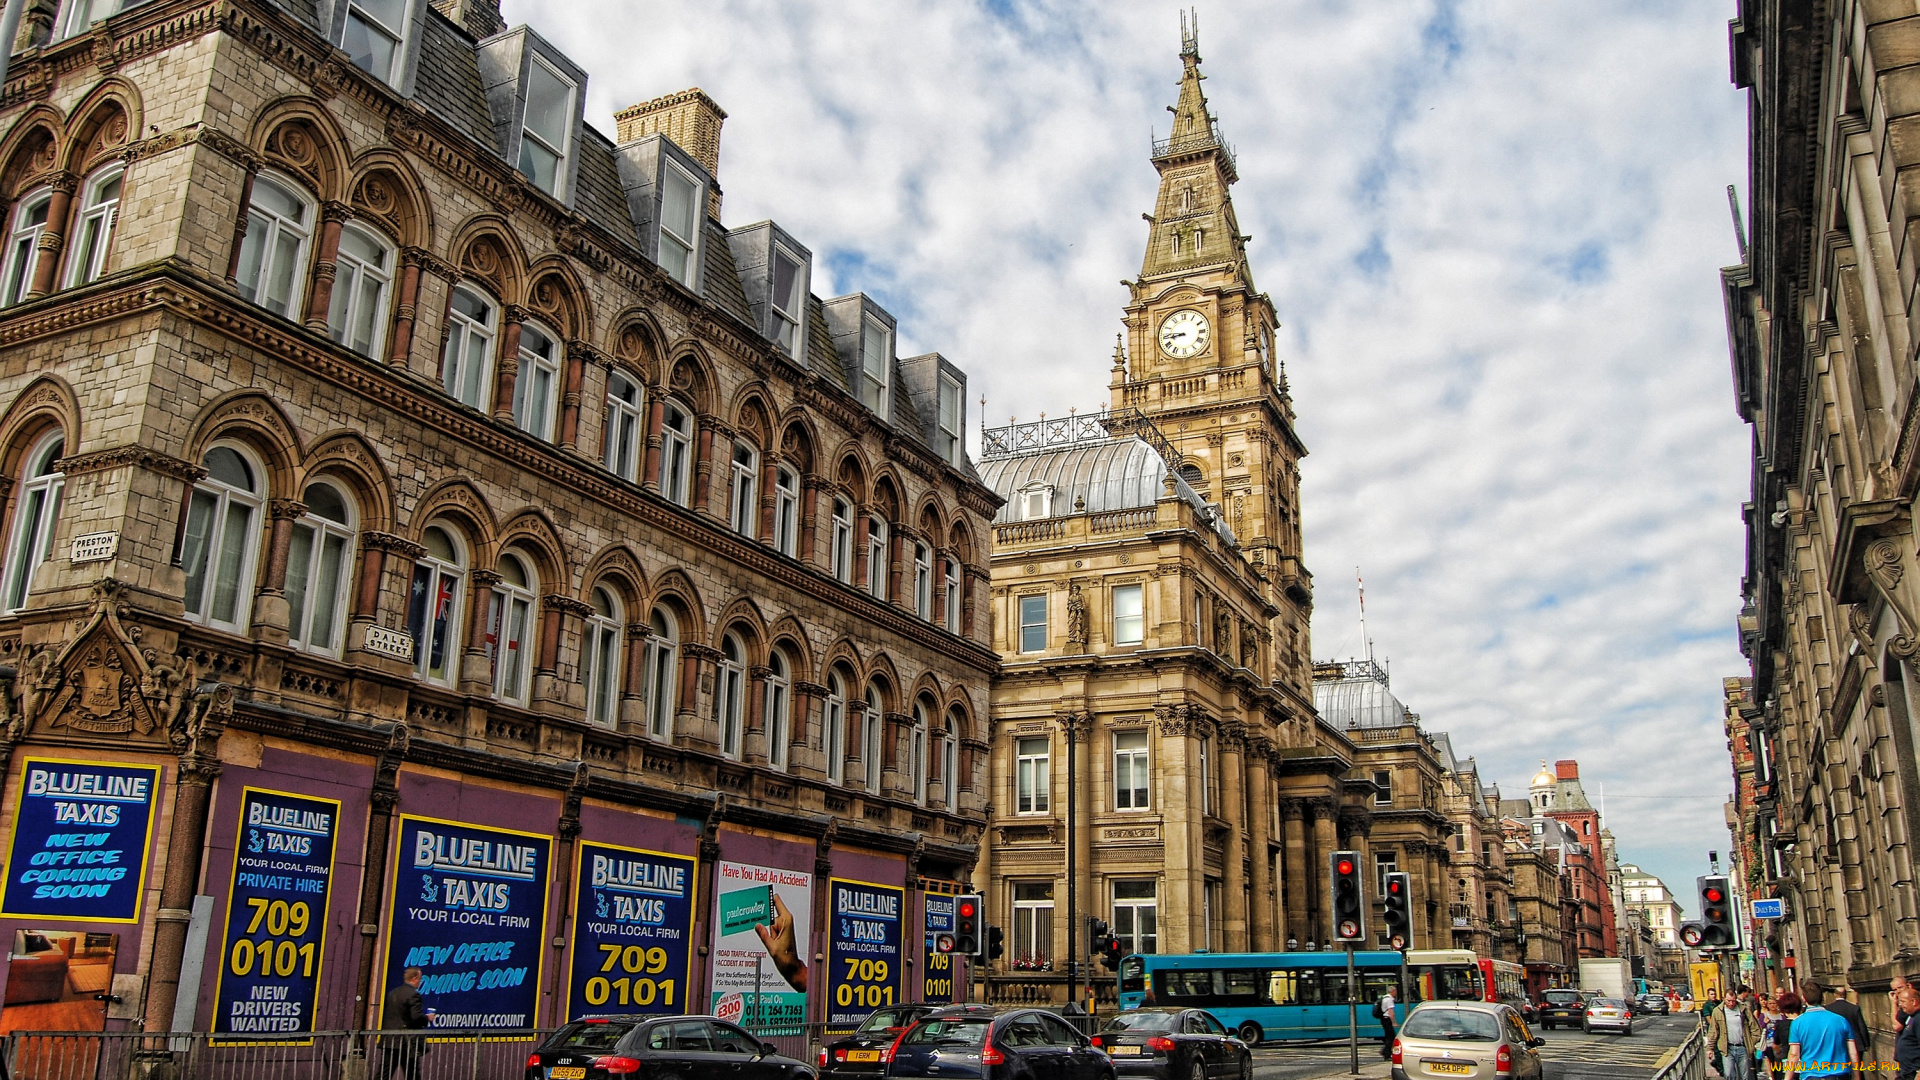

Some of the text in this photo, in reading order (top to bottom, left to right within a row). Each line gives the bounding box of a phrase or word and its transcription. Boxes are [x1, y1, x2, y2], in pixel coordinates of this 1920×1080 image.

[76, 536, 113, 548] PRESTON
[76, 546, 110, 558] STREET
[373, 630, 406, 645] DALE
[370, 639, 407, 654] STREET
[28, 770, 148, 799] BLUELINE
[54, 802, 119, 825] TAXIS
[249, 802, 330, 832] BLUELINE
[45, 833, 110, 847] NEW
[266, 832, 312, 855] TAXIS
[30, 850, 123, 866] OFFICE
[414, 830, 537, 876] BLUELINE
[240, 857, 329, 875] YOUR LOCAL FIRM
[592, 855, 685, 891] BLUELINE
[21, 867, 126, 884] COMING
[238, 872, 324, 893] PRIVATE HIRE
[722, 864, 808, 887] Have You Had An Accident?
[33, 883, 110, 899] SOON
[442, 878, 510, 909] TAXIS
[613, 896, 665, 923] TAXIS
[838, 888, 898, 916] BLUELINE
[926, 899, 953, 913] BLUELINE
[246, 897, 310, 936] 709
[408, 907, 530, 929] YOUR LOCAL FIRM
[932, 915, 948, 927] TAXIS
[588, 922, 680, 939] YOUR LOCAL FIRM
[852, 920, 885, 942] TAXIS
[404, 941, 516, 967] NEW OFFICE
[836, 941, 896, 954] YOUR LOCAL FIRM
[231, 939, 315, 977] 0101
[599, 944, 668, 974] 709
[929, 953, 948, 970] 709
[844, 957, 889, 982] 709
[416, 967, 528, 996] OMING SOON
[926, 979, 951, 996] 0101
[251, 985, 289, 1000] NEW
[585, 978, 674, 1006] 0101
[760, 995, 773, 1004] Paul
[773, 995, 784, 1004] On
[836, 983, 893, 1007] 0101
[231, 1001, 301, 1016] DRIVERS
[718, 1000, 741, 1017] £300
[768, 1006, 782, 1016] 264
[784, 1005, 803, 1016] 7363
[230, 1016, 300, 1032] WANTED
[432, 1014, 482, 1027] COMPANY
[481, 1014, 526, 1027] ACCOUNT
[832, 1013, 845, 1022] OPEN
[846, 1013, 850, 1022] A
